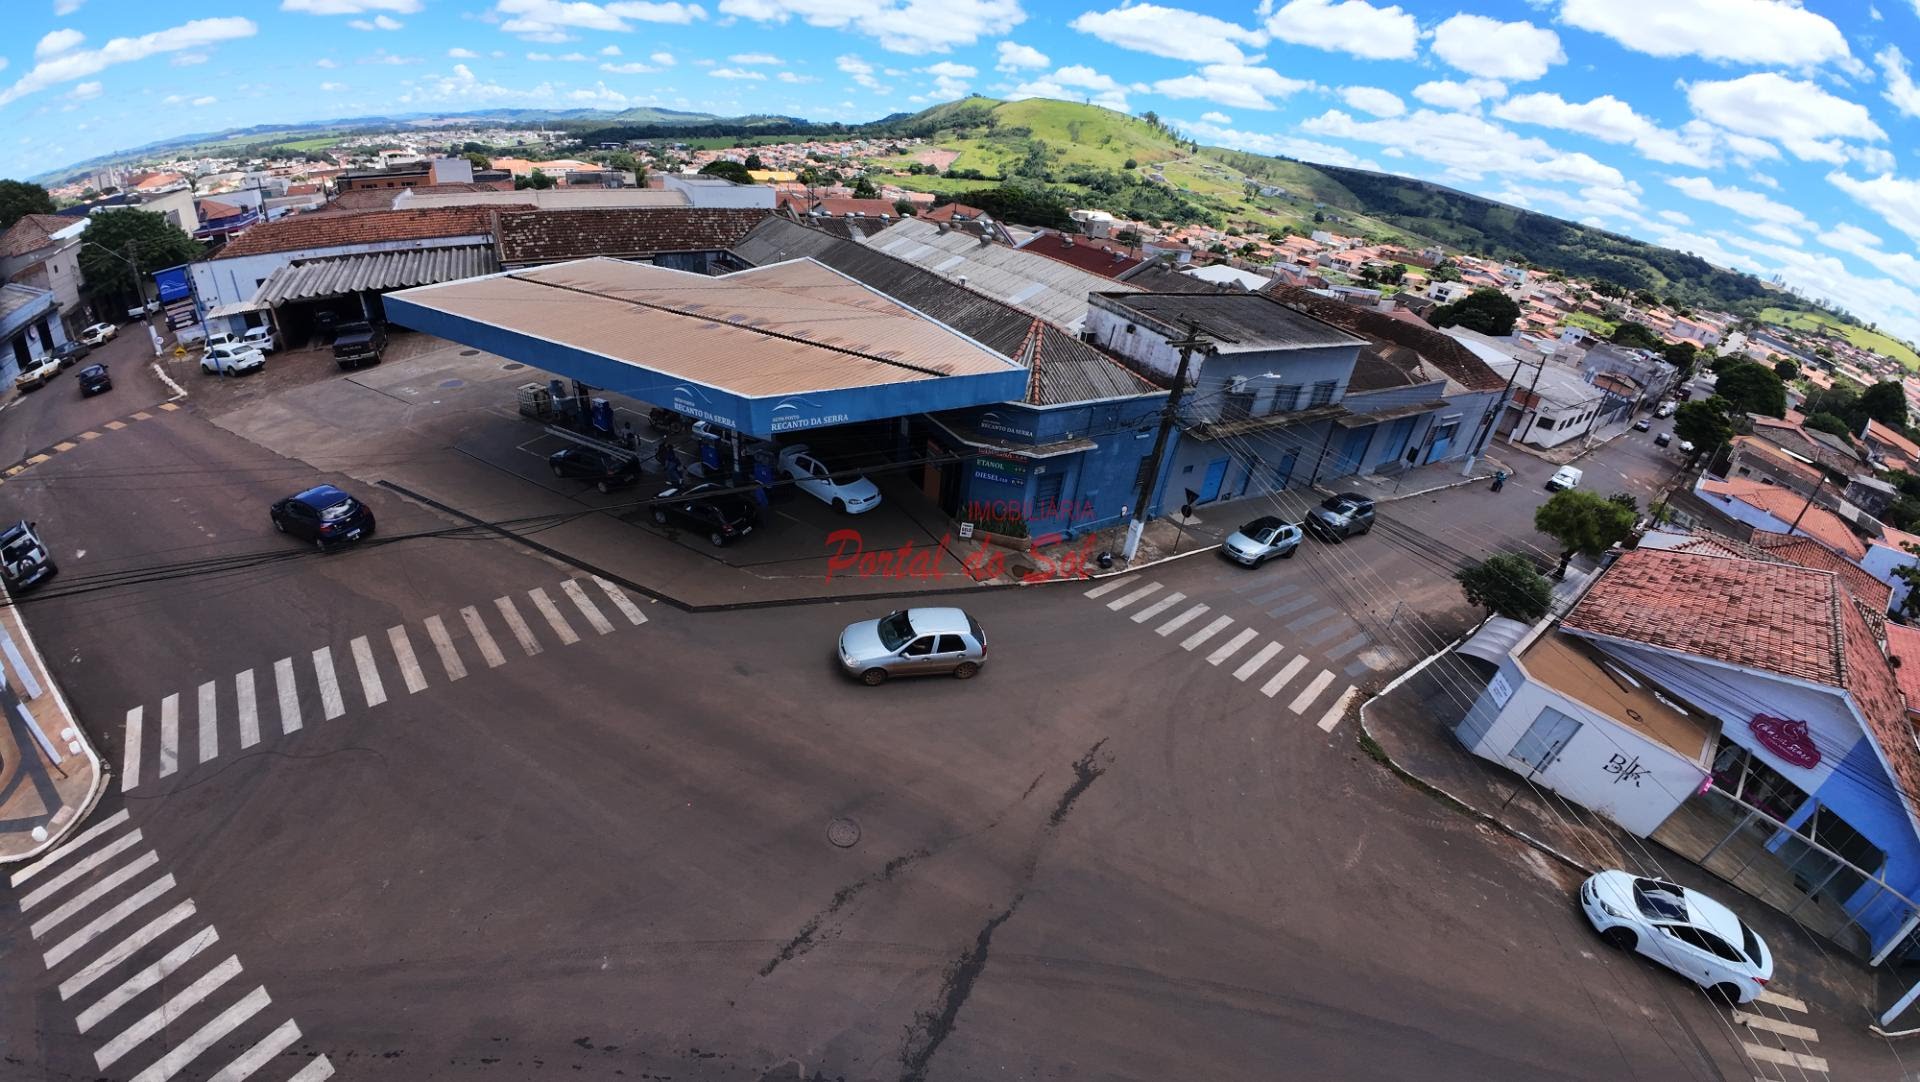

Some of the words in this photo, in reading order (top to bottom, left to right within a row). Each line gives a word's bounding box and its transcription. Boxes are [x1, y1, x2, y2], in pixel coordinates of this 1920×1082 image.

[674, 402, 703, 417] RECANTO
[704, 411, 713, 421] DA
[714, 415, 736, 428] SERRA
[771, 419, 809, 432] RECANTO
[811, 417, 822, 426] DA
[823, 414, 849, 424] SERRA
[981, 422, 1006, 432] RECANTO
[976, 458, 1004, 470] ETANOL
[975, 471, 999, 482] DIESEL
